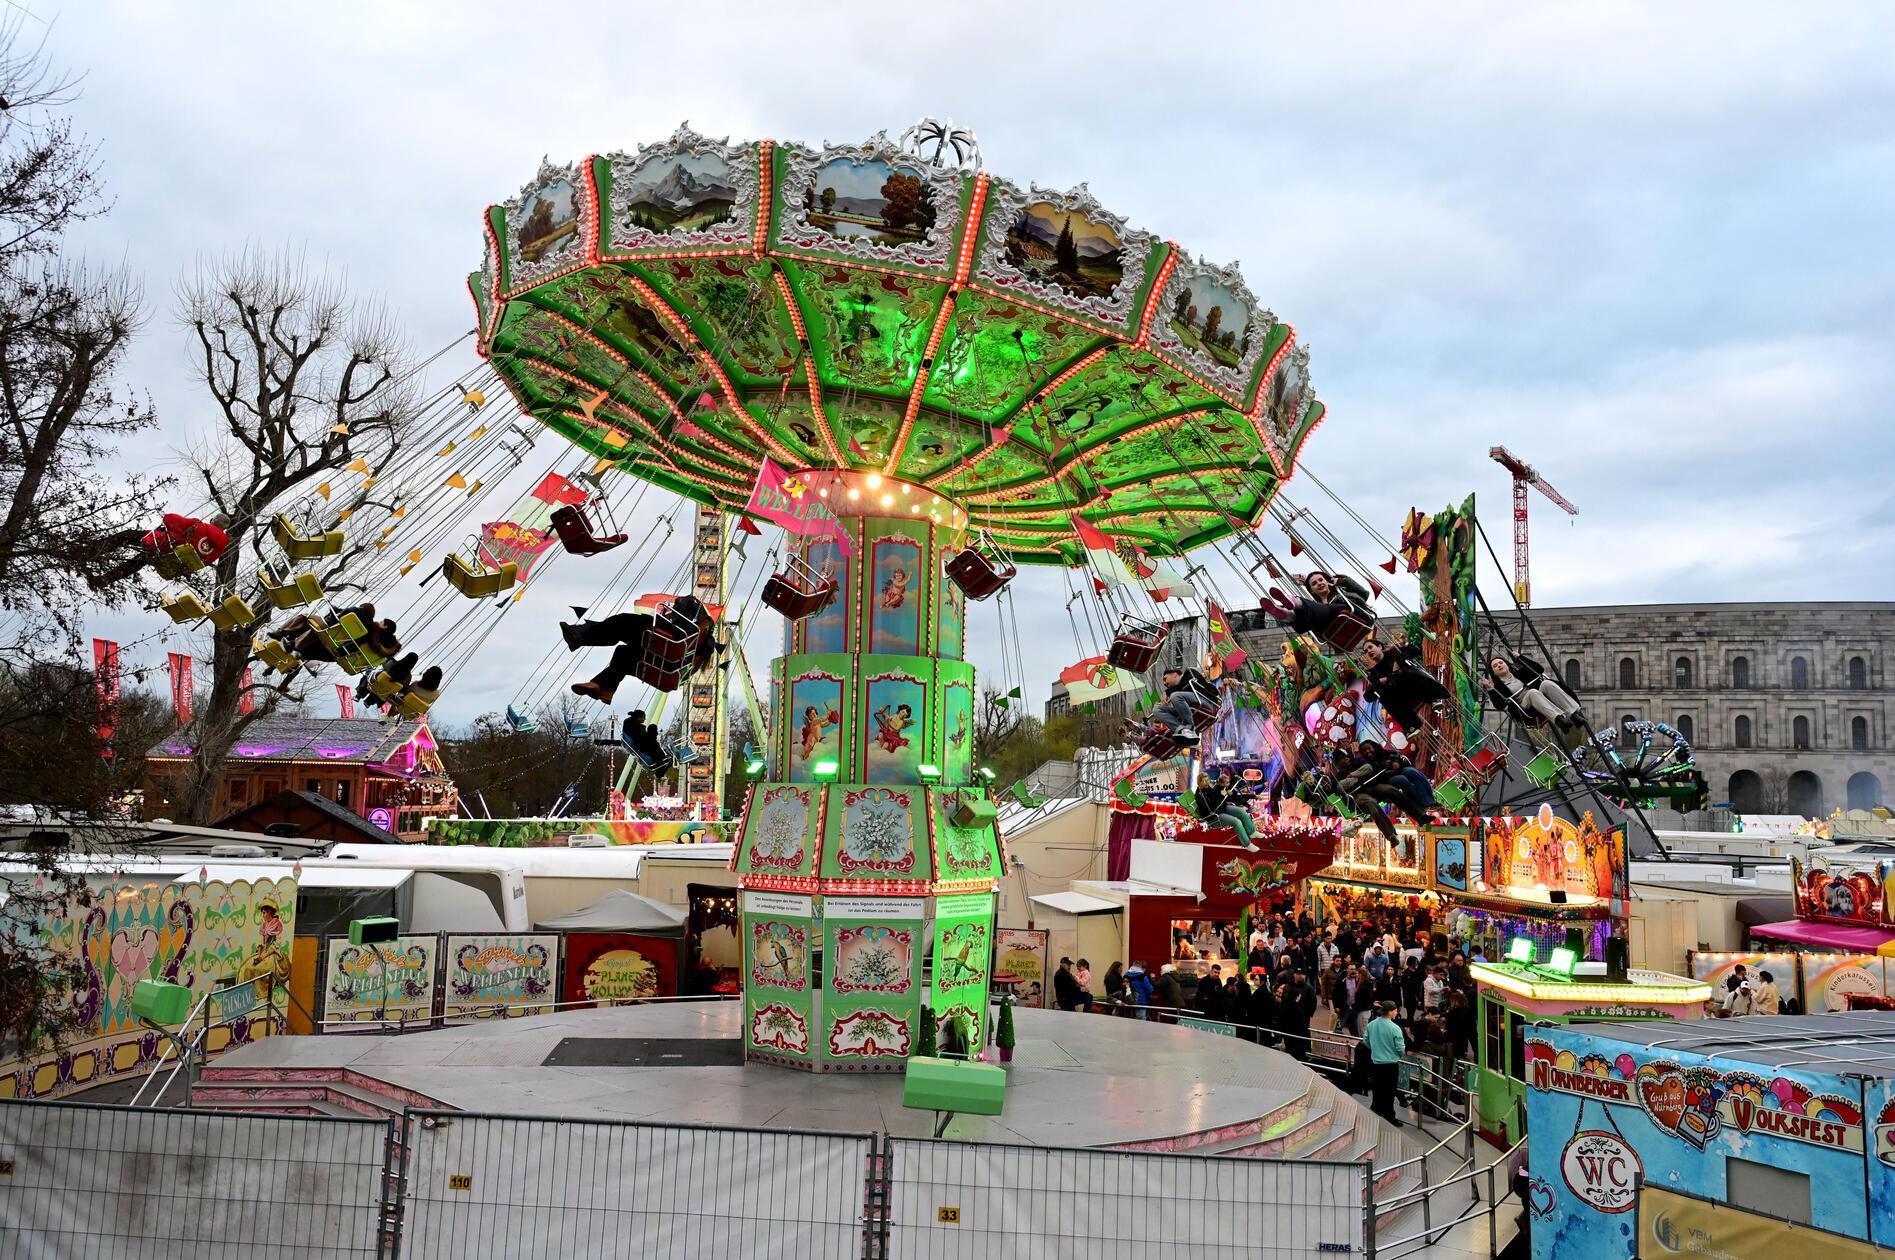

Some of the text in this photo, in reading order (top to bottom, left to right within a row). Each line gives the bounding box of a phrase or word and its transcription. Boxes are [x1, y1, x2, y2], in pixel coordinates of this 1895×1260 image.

[1829, 972, 1877, 992] Kinderkarussell
[1669, 1093, 1681, 1102] aus
[1654, 1102, 1683, 1115] Nürnberg
[1733, 1099, 1847, 1146] VOLKSFEST
[1575, 1156, 1628, 1187] WC
[451, 1177, 470, 1188] 110
[941, 1209, 957, 1221] 33
[1688, 1228, 1712, 1243] VBM
[1319, 1243, 1351, 1251] HERAS
